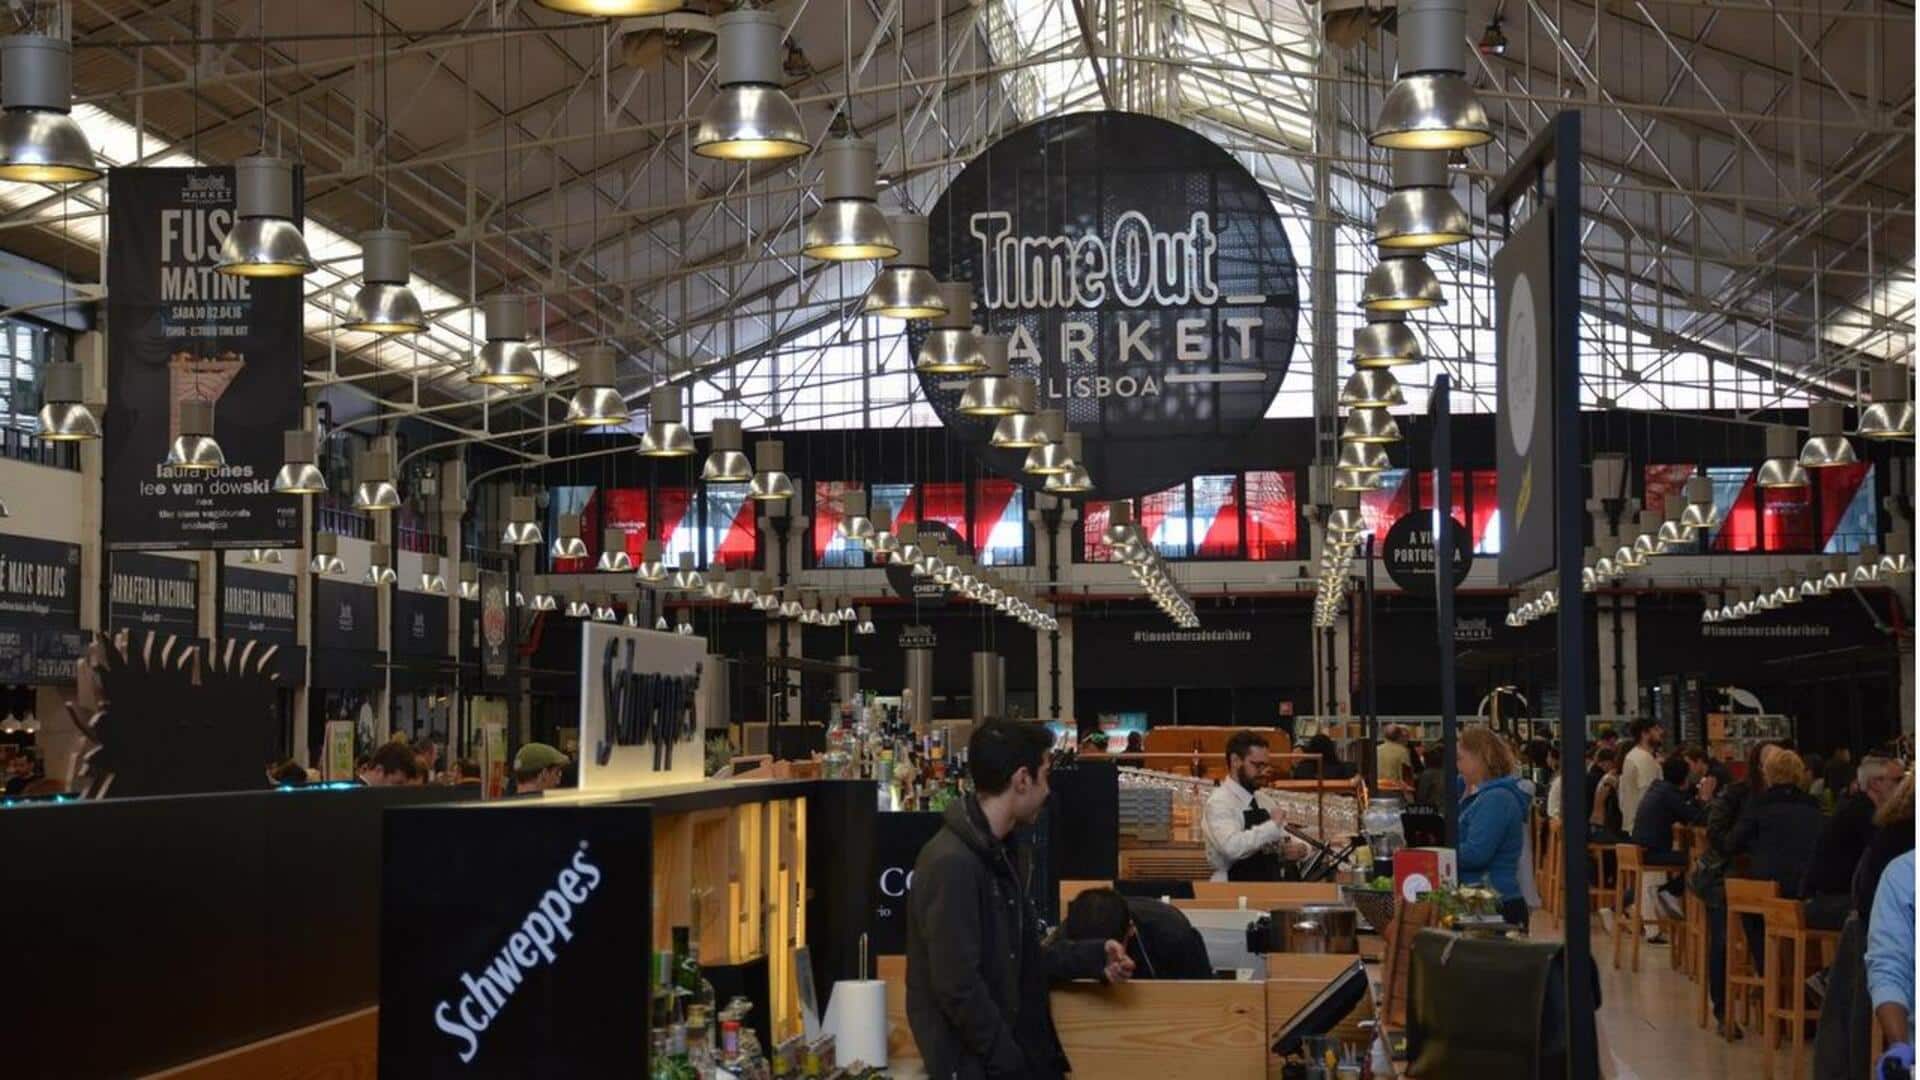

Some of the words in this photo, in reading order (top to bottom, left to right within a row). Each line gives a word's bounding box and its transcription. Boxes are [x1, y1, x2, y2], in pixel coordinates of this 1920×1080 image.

[161, 209, 238, 262] FUS
[972, 317, 1263, 368] ARKET
[1049, 375, 1160, 399] LISBOA
[203, 464, 254, 481] jones
[140, 480, 166, 495] lee
[172, 482, 204, 495] van
[209, 479, 270, 495] dowski
[1409, 531, 1417, 545] A
[1393, 548, 1462, 563] PORTUGA
[112, 573, 157, 607] ARRAFEIRA
[224, 586, 261, 616] ARRAFEIRA
[435, 850, 601, 1063] Schweppes
